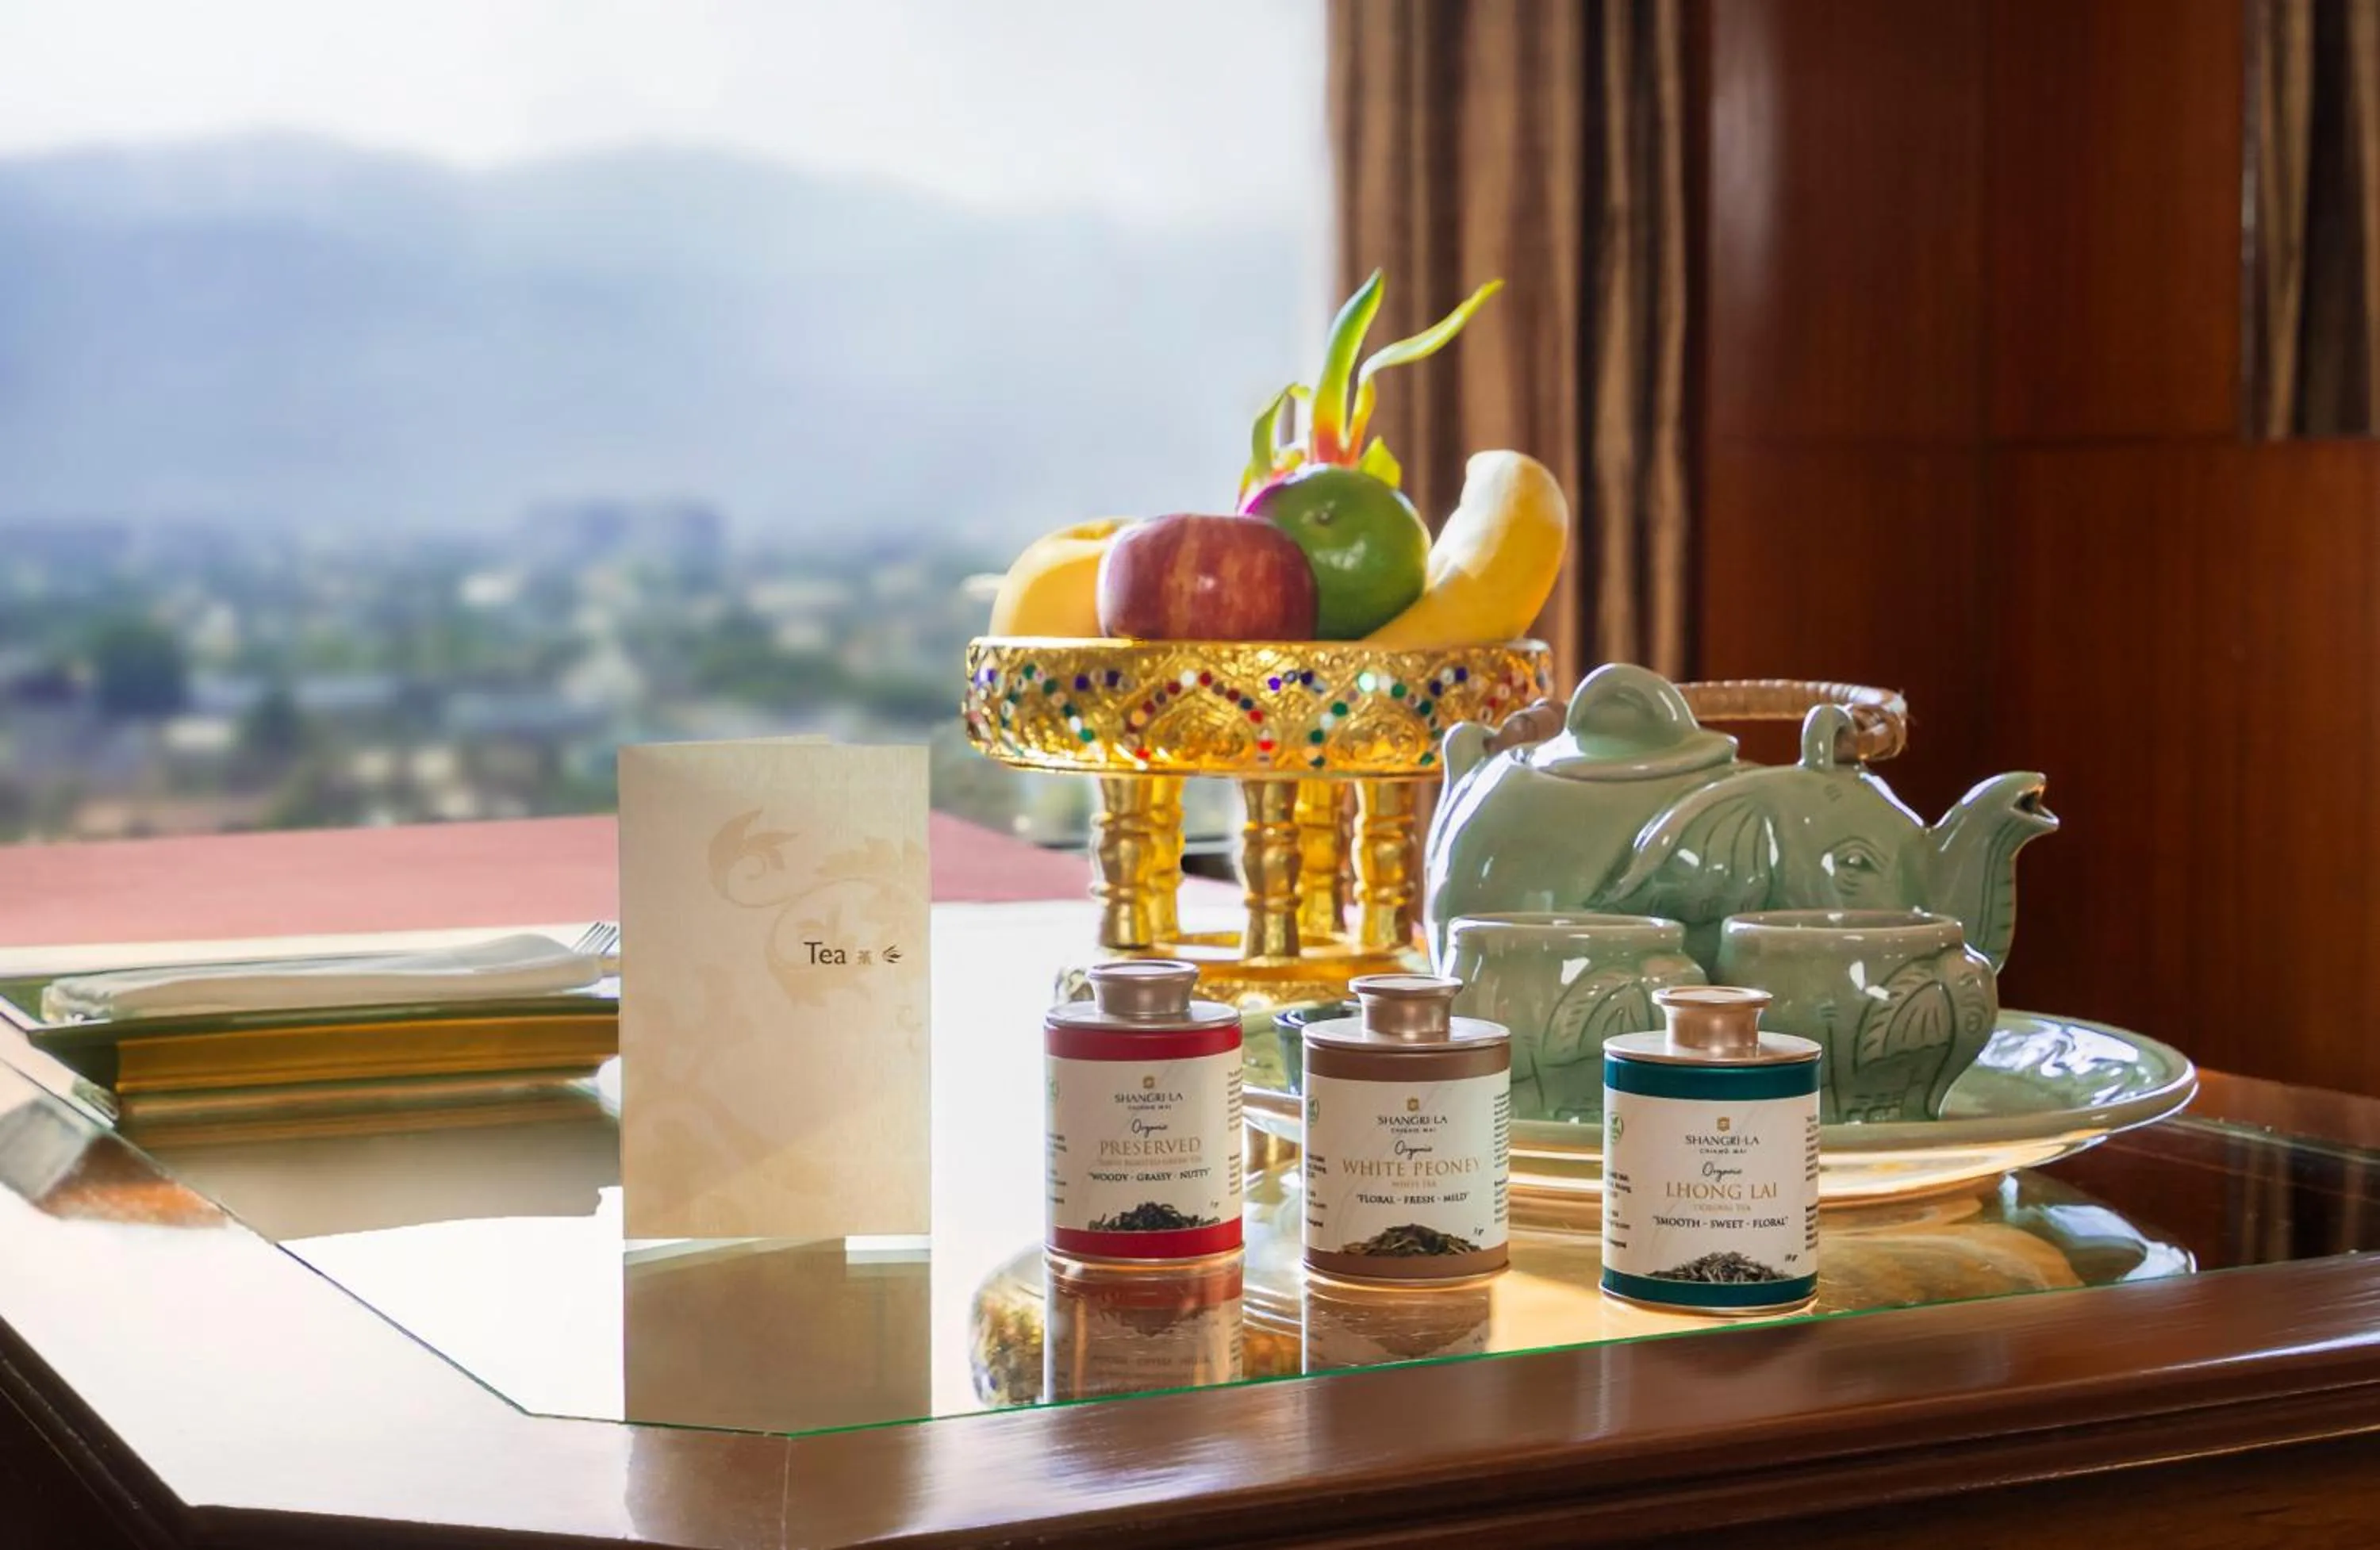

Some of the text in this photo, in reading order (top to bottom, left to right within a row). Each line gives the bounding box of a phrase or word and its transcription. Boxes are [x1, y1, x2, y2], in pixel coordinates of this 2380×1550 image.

[804, 941, 846, 965] Tea
[1099, 1135, 1202, 1156] PRESERVED
[1342, 1157, 1405, 1178] WHITE
[1403, 1195, 1435, 1204] FRESH
[1666, 1181, 1777, 1200] LHONG LAI
[1710, 1218, 1745, 1229] SWEET
